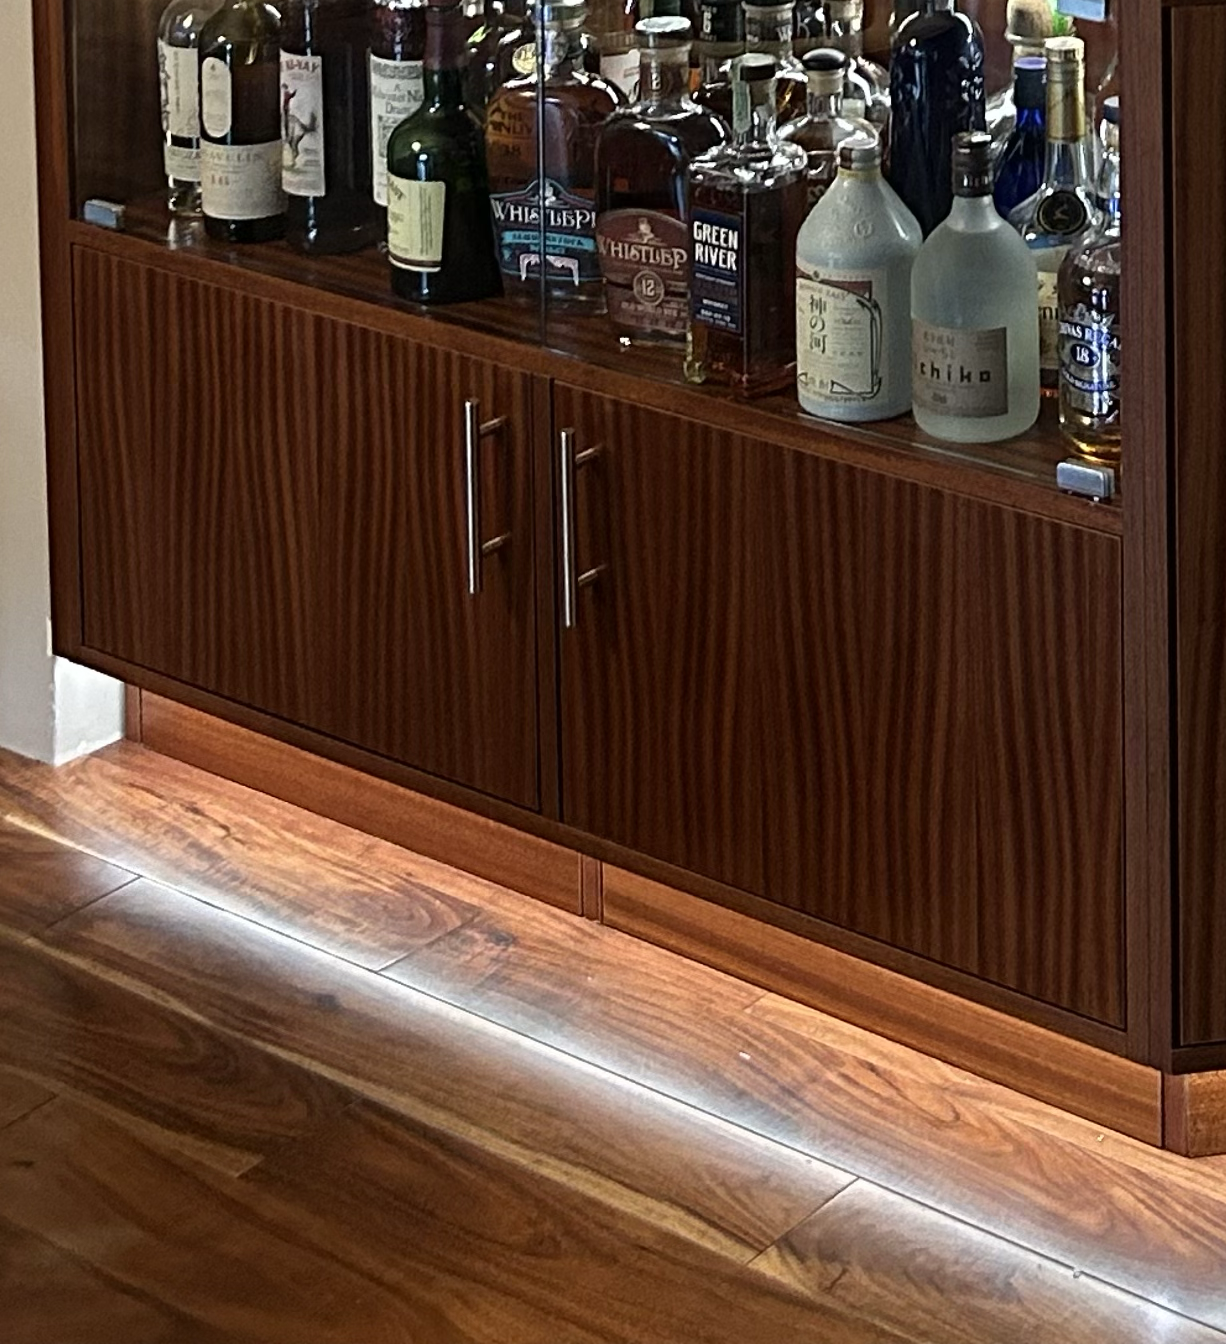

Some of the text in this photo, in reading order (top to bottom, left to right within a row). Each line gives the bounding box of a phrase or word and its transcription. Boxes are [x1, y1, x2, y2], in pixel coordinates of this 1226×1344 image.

[693, 220, 739, 251] GREEN
[694, 242, 738, 272] RIVER
[914, 357, 992, 384] chiko
